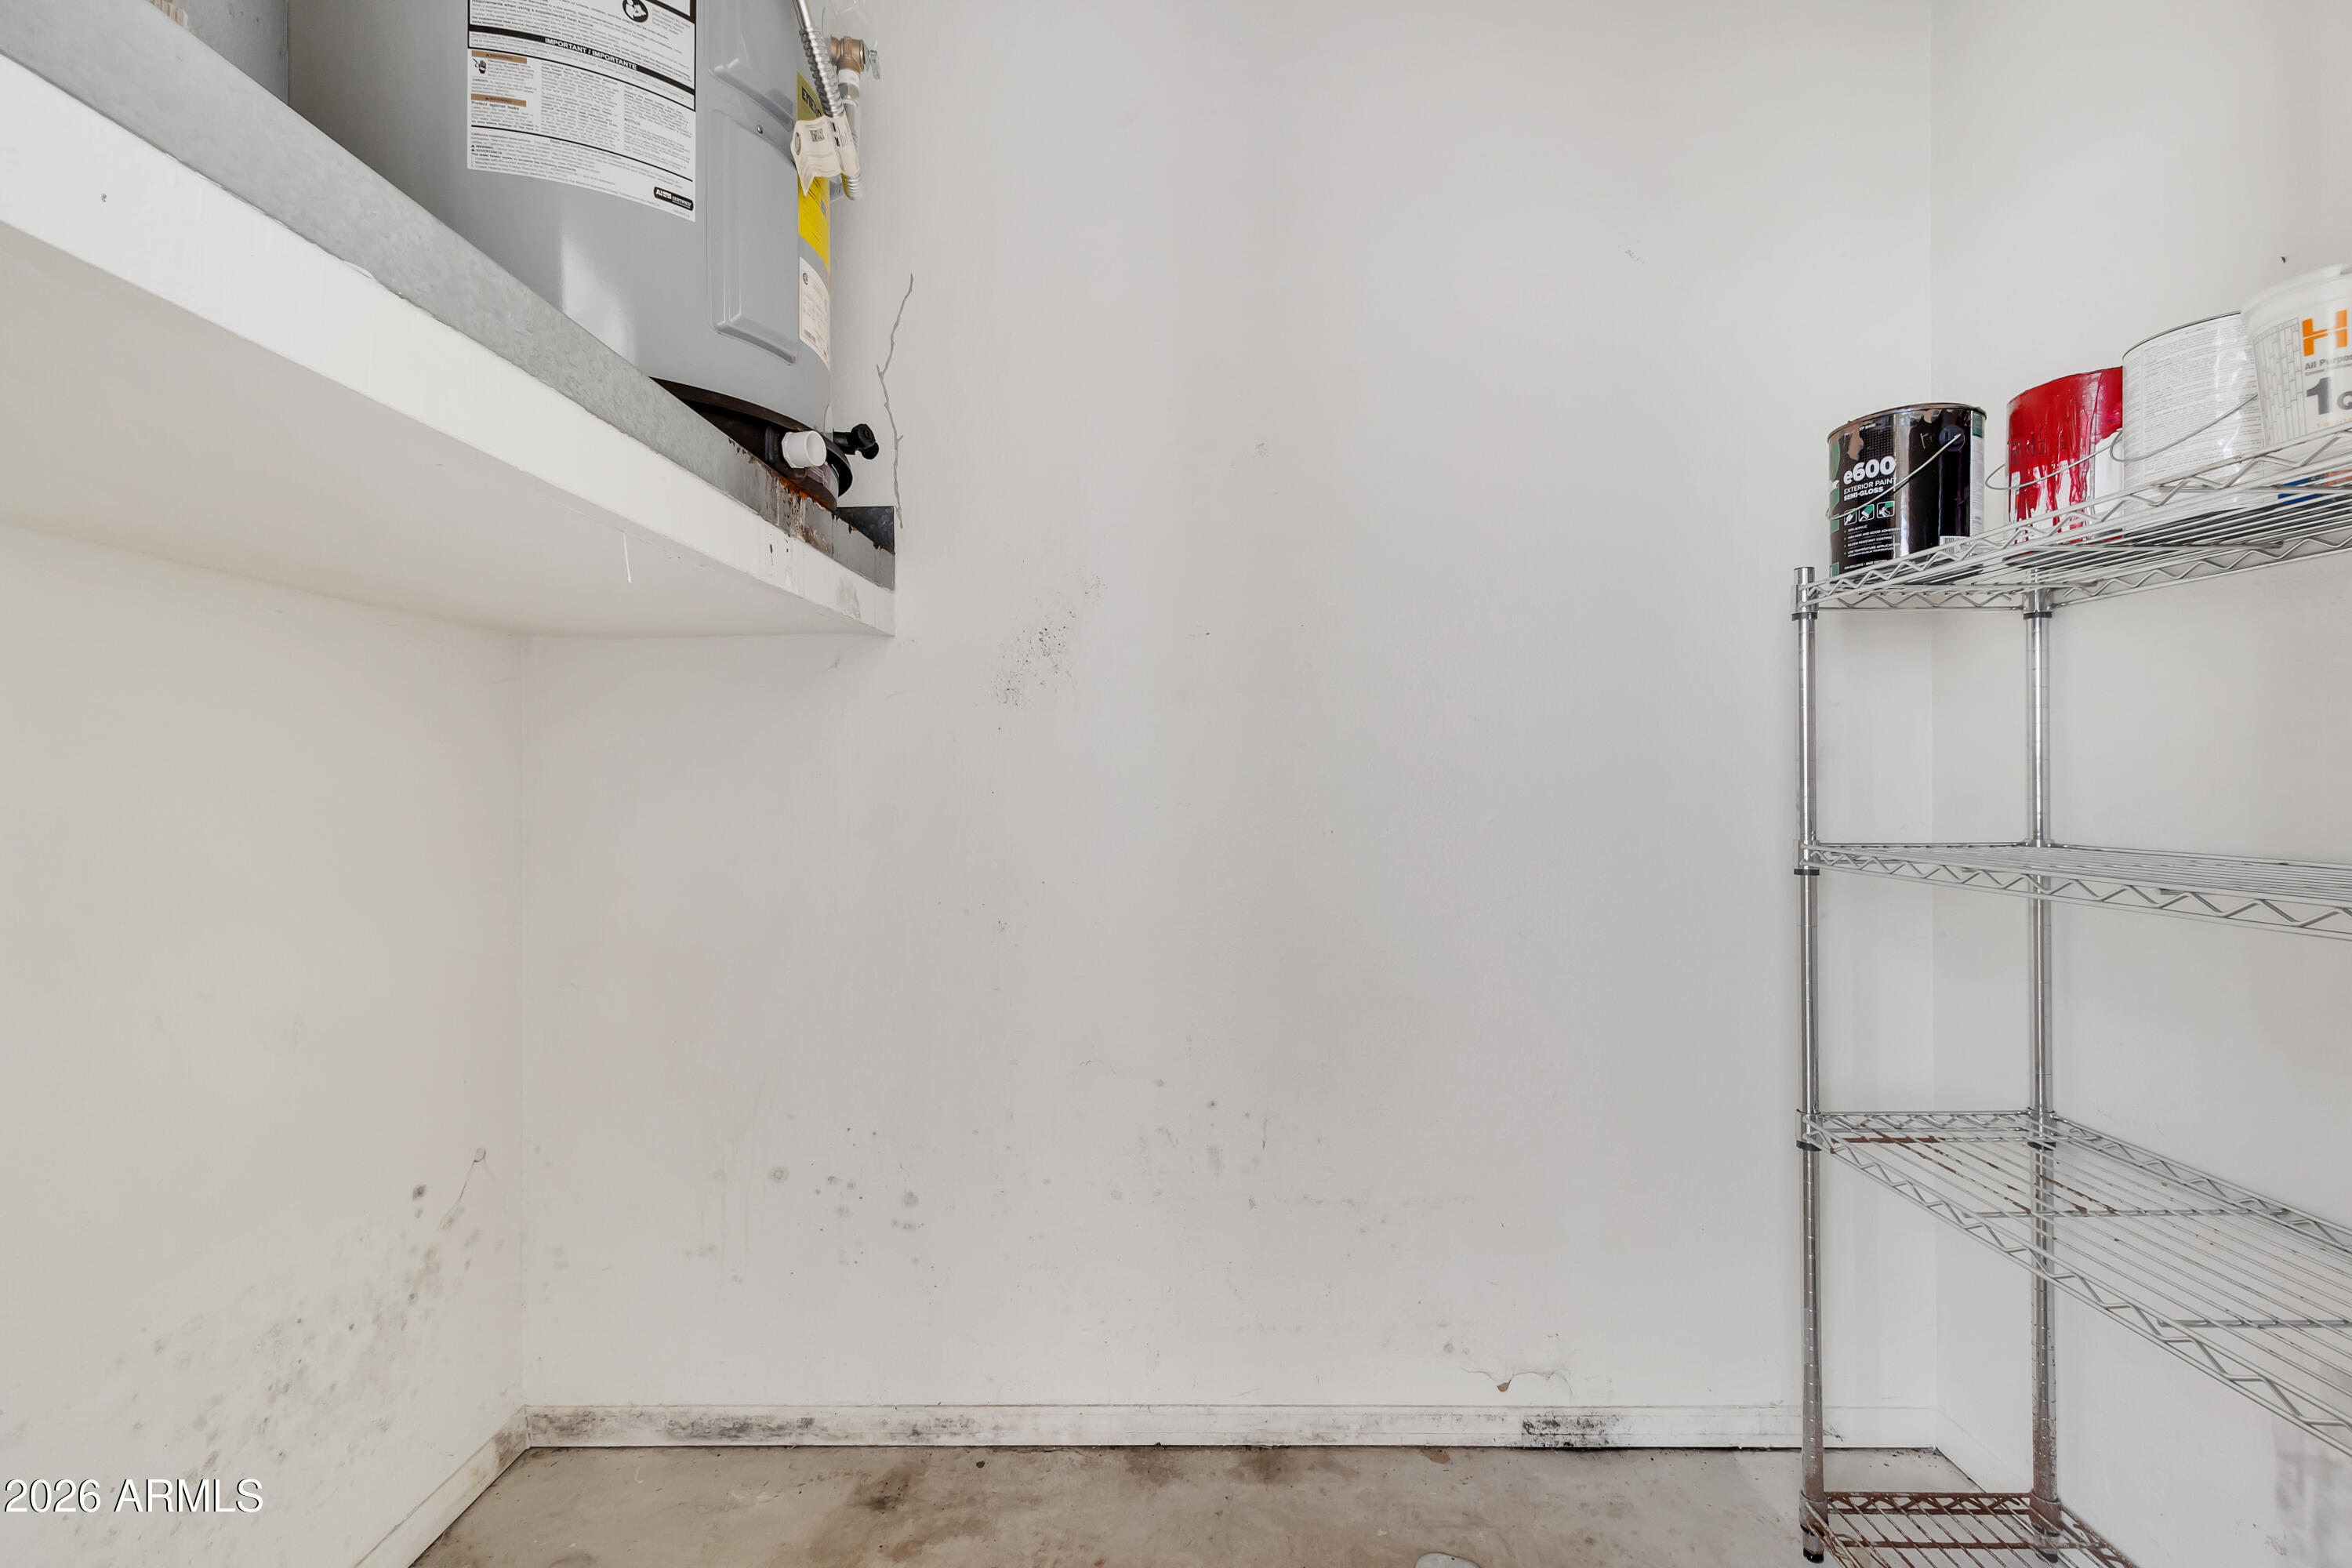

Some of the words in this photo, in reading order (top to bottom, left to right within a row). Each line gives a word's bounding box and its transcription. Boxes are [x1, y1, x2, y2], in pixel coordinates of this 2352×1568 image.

[545, 38, 586, 54] IMPORTANT
[592, 49, 637, 71] IMPORTANTE
[2304, 361, 2317, 370] All
[2307, 376, 2331, 415] 1
[1843, 456, 1896, 485] e600
[1844, 481, 1874, 495] EXTERIOR
[1875, 477, 1897, 487] PAINT
[1844, 486, 1884, 501] SEMI-GLOSS
